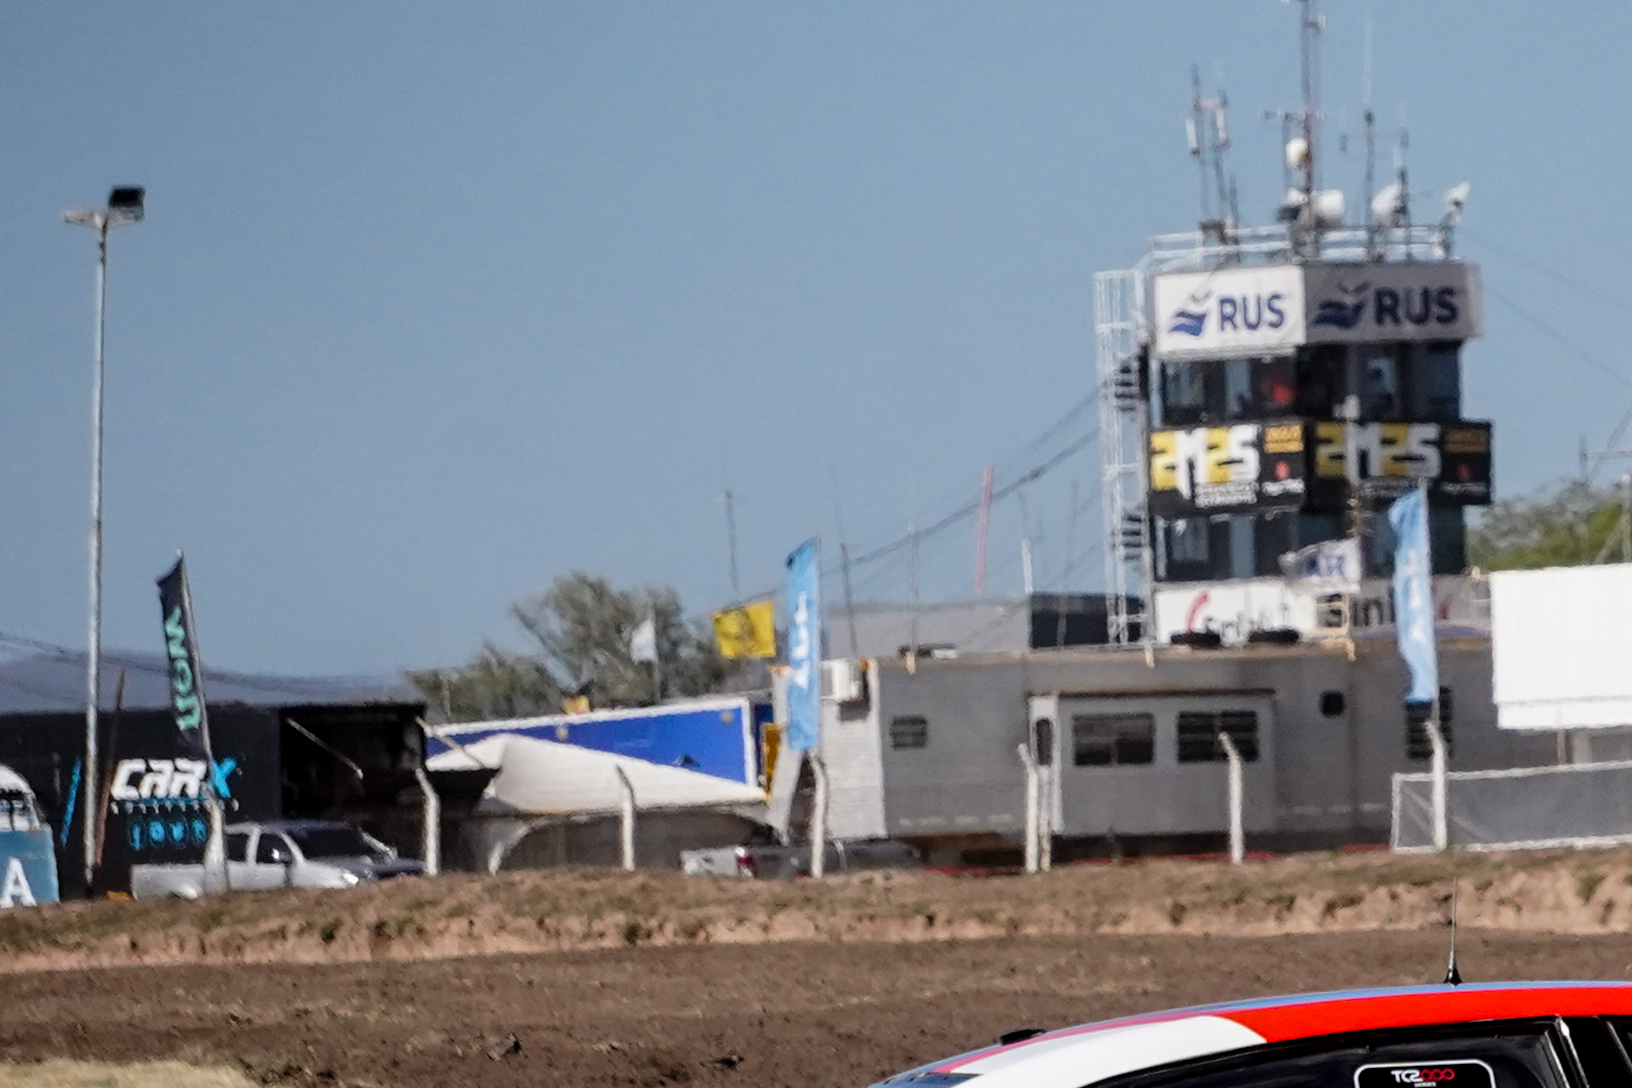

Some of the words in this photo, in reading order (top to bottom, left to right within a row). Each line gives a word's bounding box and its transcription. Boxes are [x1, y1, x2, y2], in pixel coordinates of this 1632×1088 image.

[1219, 294, 1287, 333] RUS
[1373, 286, 1459, 326] RUS
[1390, 1067, 1456, 1083] TC2000
